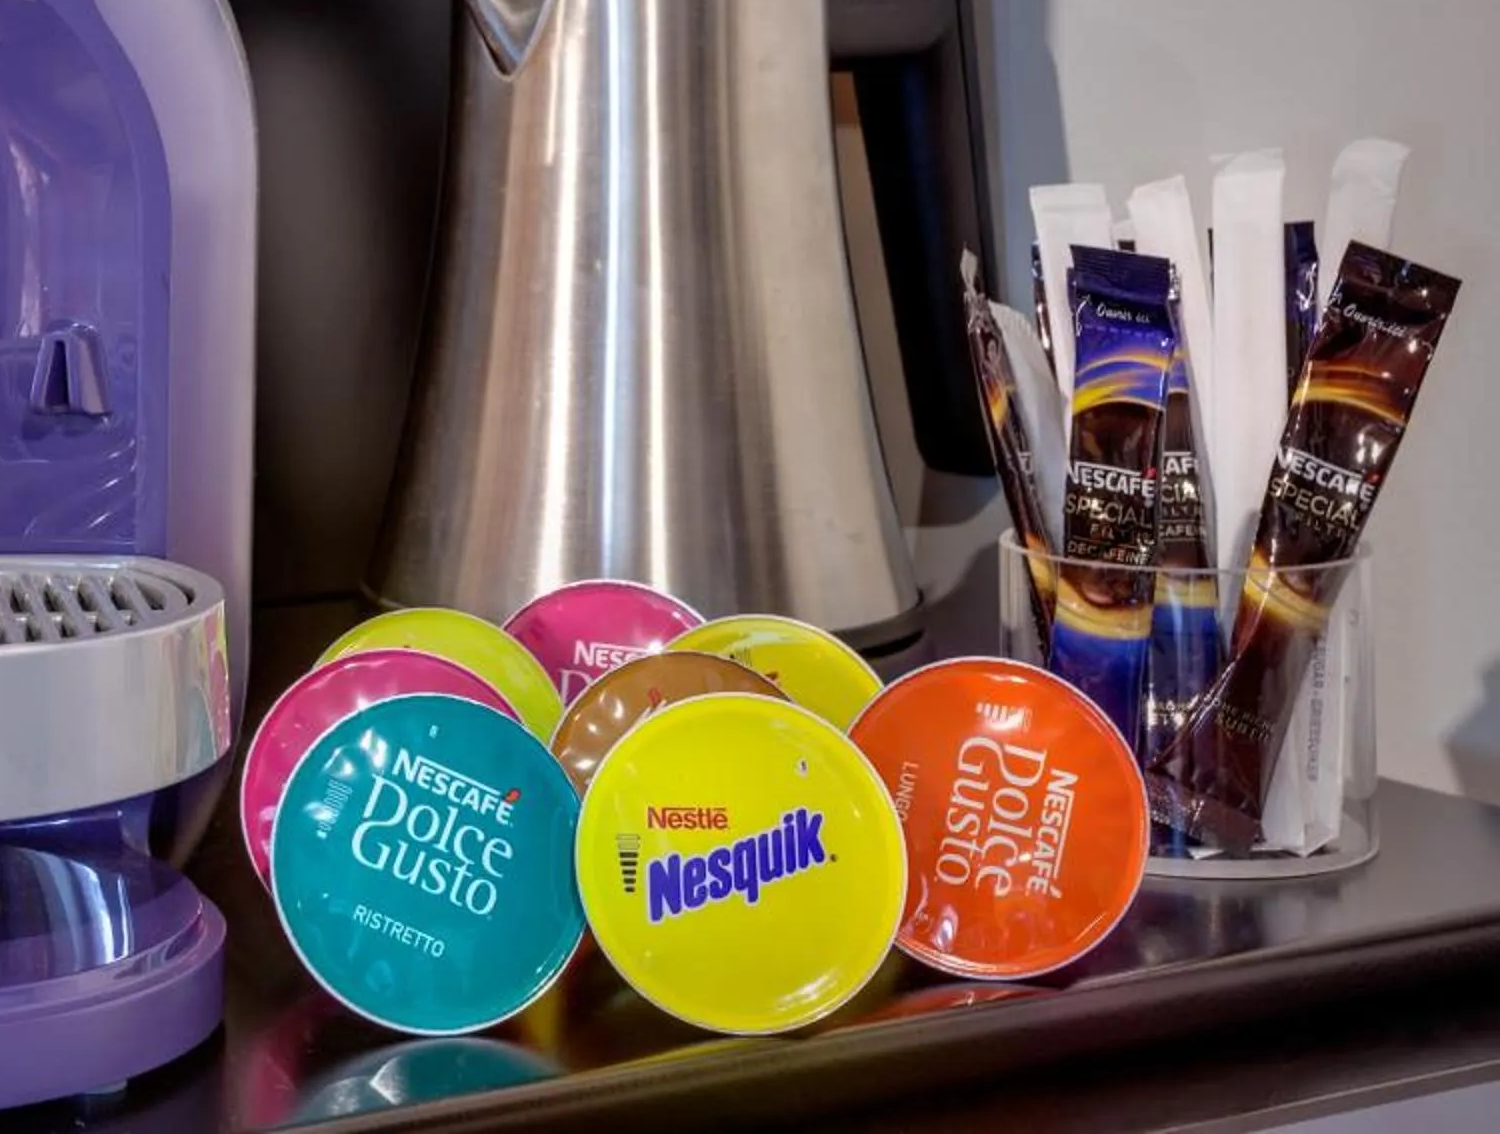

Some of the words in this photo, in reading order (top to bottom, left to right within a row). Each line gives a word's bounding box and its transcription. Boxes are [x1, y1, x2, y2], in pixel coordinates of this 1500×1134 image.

[1065, 493, 1154, 530] SPECIAL
[1268, 476, 1361, 531] SPECIAL
[363, 772, 513, 878] Dolce
[392, 747, 521, 827] NESCAFÉ
[935, 736, 1002, 886] Gusto
[975, 742, 1047, 897] Dolce
[1026, 768, 1079, 899] NESCAFÉ
[351, 820, 498, 915] Gusto
[647, 807, 826, 925] Nesquik
[353, 904, 446, 958] RISTRETTO
